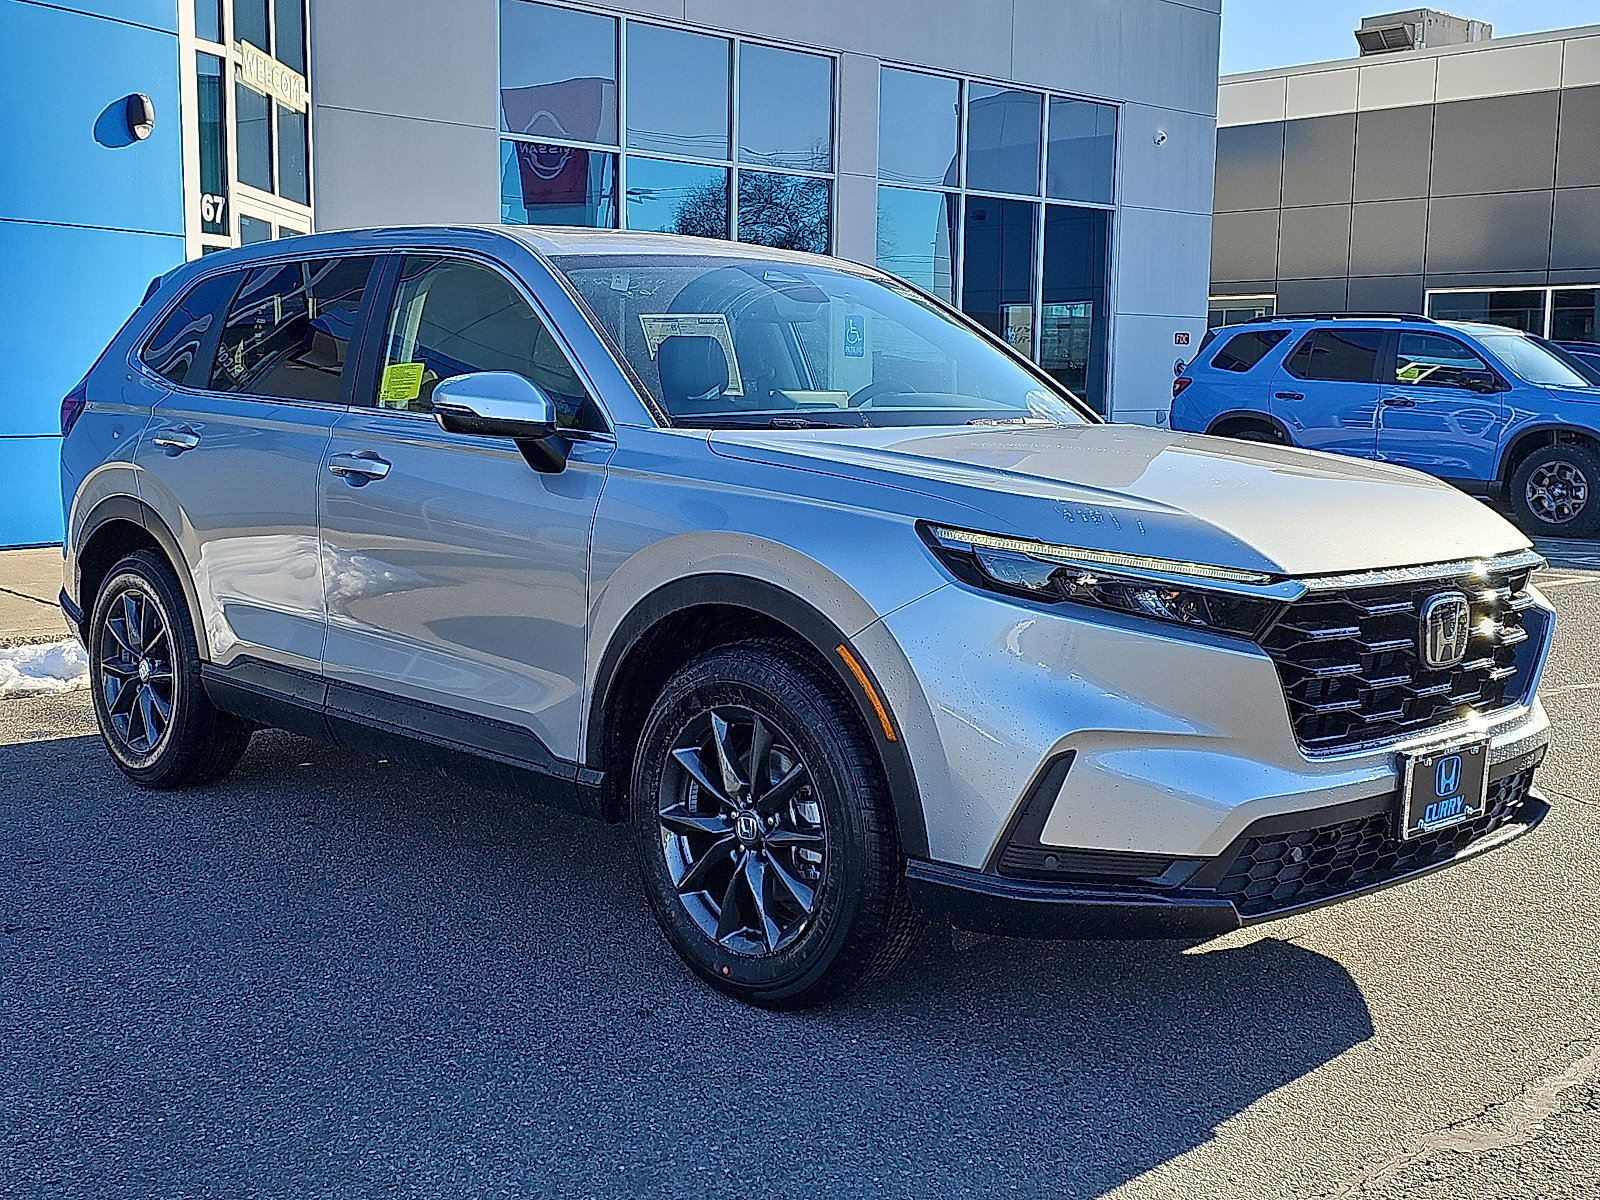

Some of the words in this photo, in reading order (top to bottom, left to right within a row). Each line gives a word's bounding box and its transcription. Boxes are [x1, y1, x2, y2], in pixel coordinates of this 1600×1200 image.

[242, 48, 304, 108] WELCOME
[202, 194, 225, 224] 67
[1425, 794, 1465, 822] CURRY
